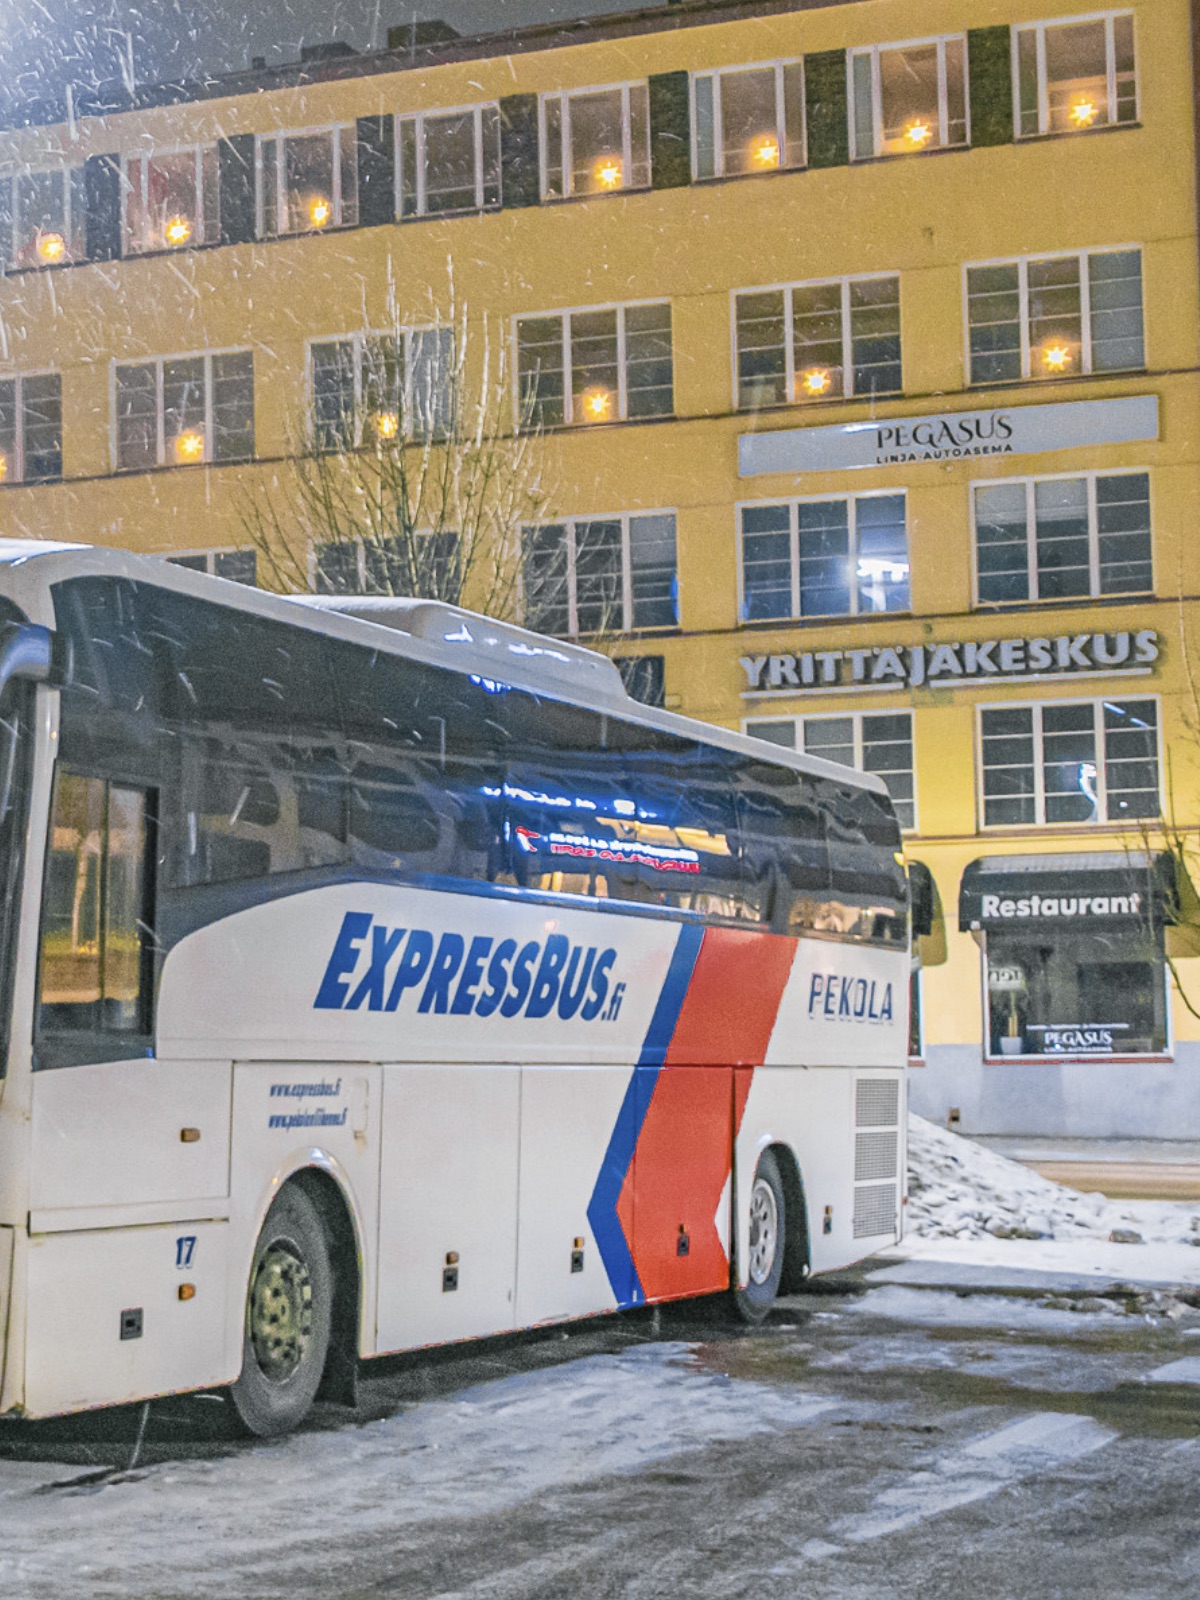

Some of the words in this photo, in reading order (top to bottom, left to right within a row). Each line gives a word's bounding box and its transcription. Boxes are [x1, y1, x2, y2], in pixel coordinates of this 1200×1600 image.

[877, 412, 1013, 448] PEGASUS
[740, 631, 1158, 686] YRITTÄJÄKESKUS
[981, 892, 1140, 918] Restaurant
[808, 973, 892, 1020] PEKOLA
[1044, 1029, 1113, 1046] PEGASUS
[176, 1236, 197, 1266] 17
